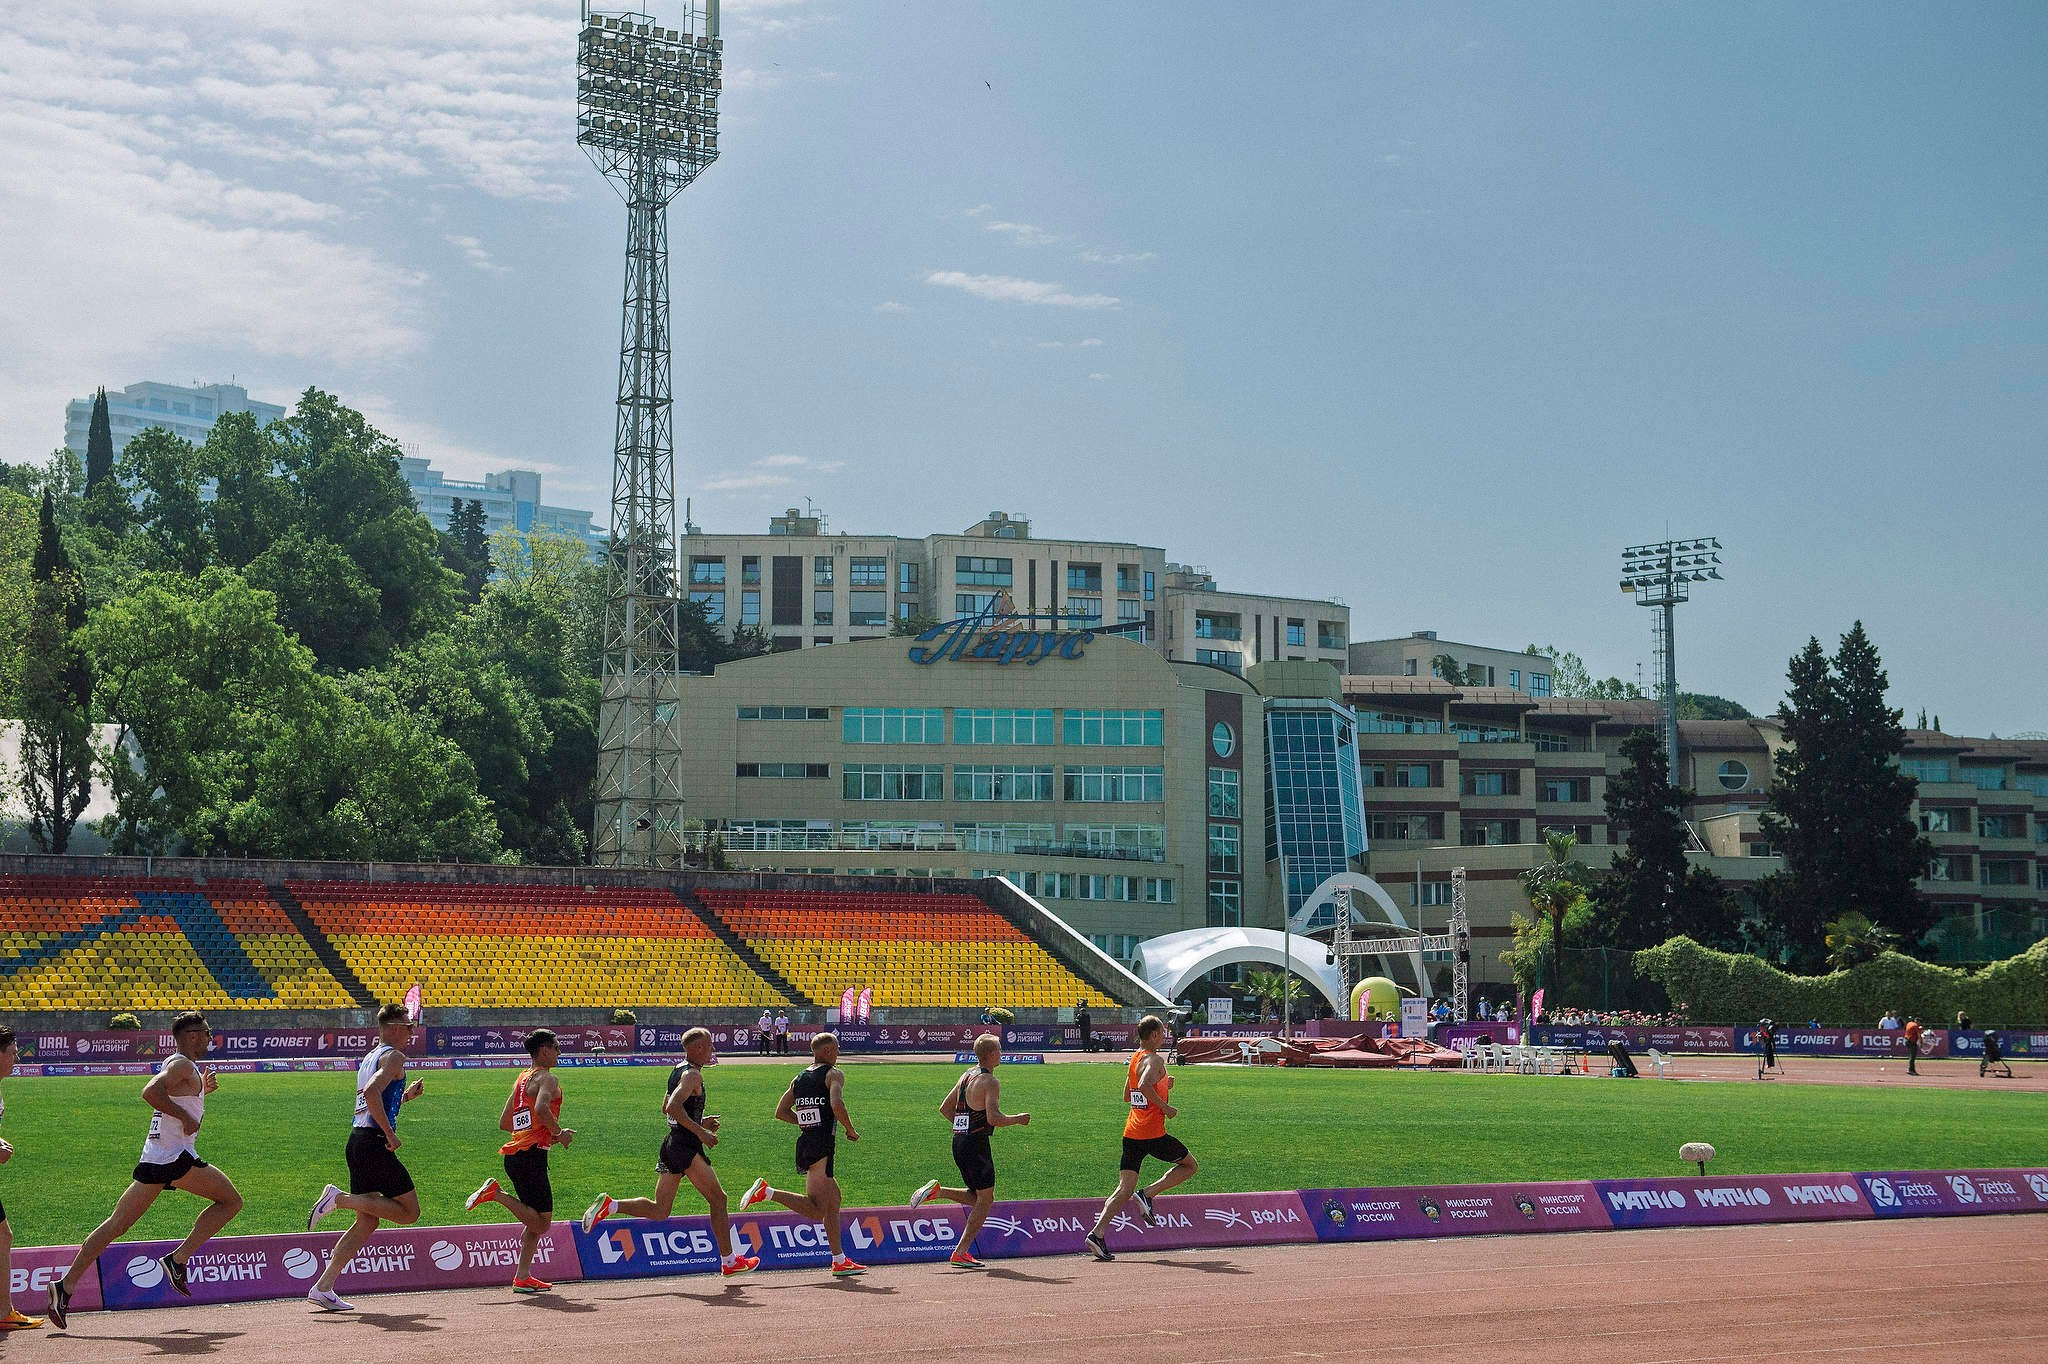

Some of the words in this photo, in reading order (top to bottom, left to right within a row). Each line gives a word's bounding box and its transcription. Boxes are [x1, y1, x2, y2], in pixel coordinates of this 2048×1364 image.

[908, 594, 1103, 665] Парус
[39, 1036, 70, 1049] URAL
[227, 1036, 258, 1049] ПСБ
[262, 1036, 312, 1048] FONBET
[337, 1035, 366, 1047] ПСБ
[484, 1041, 506, 1049] ВФЛА
[607, 1039, 628, 1047] ВФЛА
[1016, 1035, 1044, 1044] ЛИЗИНГ
[1586, 1039, 1606, 1047] ВФЛА
[1683, 1040, 1705, 1048] ВФЛА
[1708, 1040, 1729, 1048] ВФЛА
[1793, 1034, 1839, 1045] FONBET
[1862, 1035, 1891, 1046] ПСБ
[91, 1043, 130, 1052] ЛИЗИНГ
[800, 1111, 817, 1121] 081
[1899, 1183, 1938, 1197] zetta
[1978, 1180, 2017, 1195] zetta
[1445, 1198, 1493, 1209] МИНСПОРТ
[1539, 1194, 1586, 1205] МИНСПОРТ
[1907, 1198, 1943, 1207] GROUP
[1351, 1201, 1401, 1212] МИНСПОРТ
[1543, 1205, 1581, 1216] РОССИИ
[1251, 1208, 1301, 1225] ВФЛА
[1356, 1213, 1396, 1223] РОССИИ
[1450, 1210, 1489, 1220] РОССИИ
[1032, 1216, 1085, 1233] ВФЛА
[889, 1218, 955, 1243] ПСБ
[642, 1229, 713, 1256] ПСБ
[649, 1258, 689, 1266] ГЕНЕРАЛЬНЫЙ
[186, 1263, 268, 1283] ИЗИНГ
